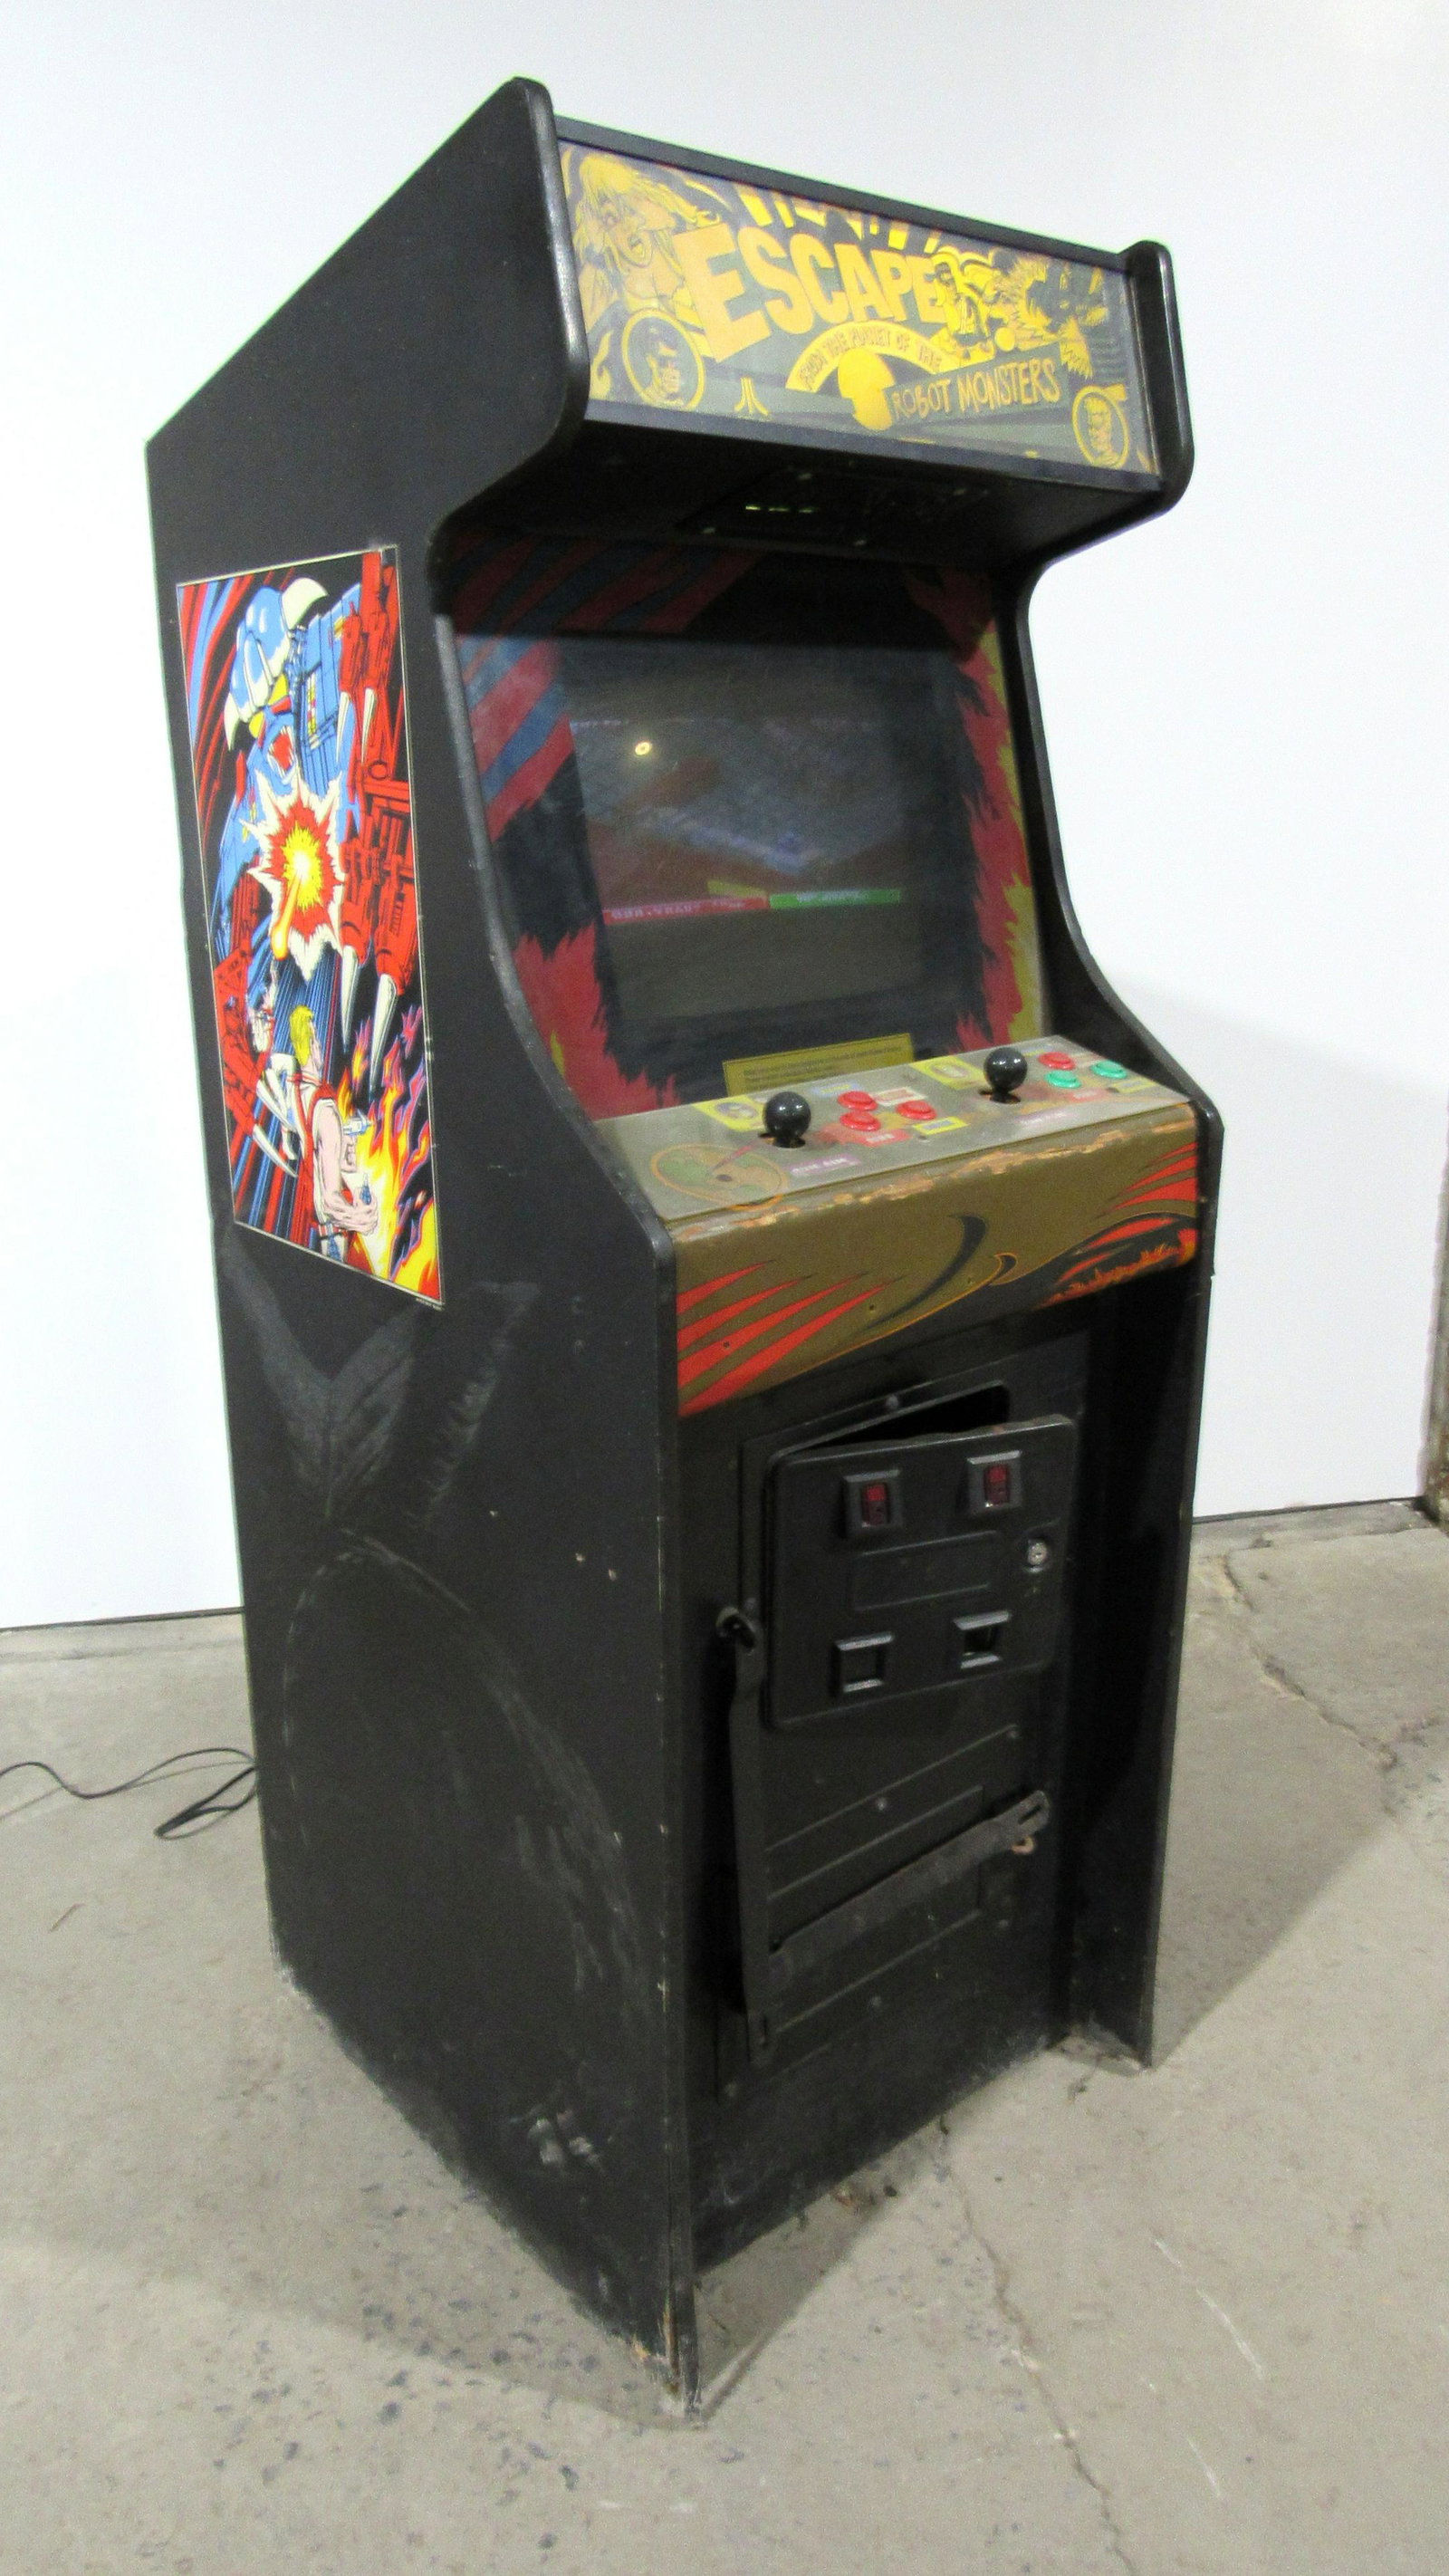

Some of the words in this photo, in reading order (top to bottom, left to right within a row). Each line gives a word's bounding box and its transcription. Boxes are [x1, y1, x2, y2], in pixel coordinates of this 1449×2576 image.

[672, 223, 948, 362] ESCAPE
[891, 378, 952, 419] ROBOT
[957, 357, 1061, 412] MONSTERS
